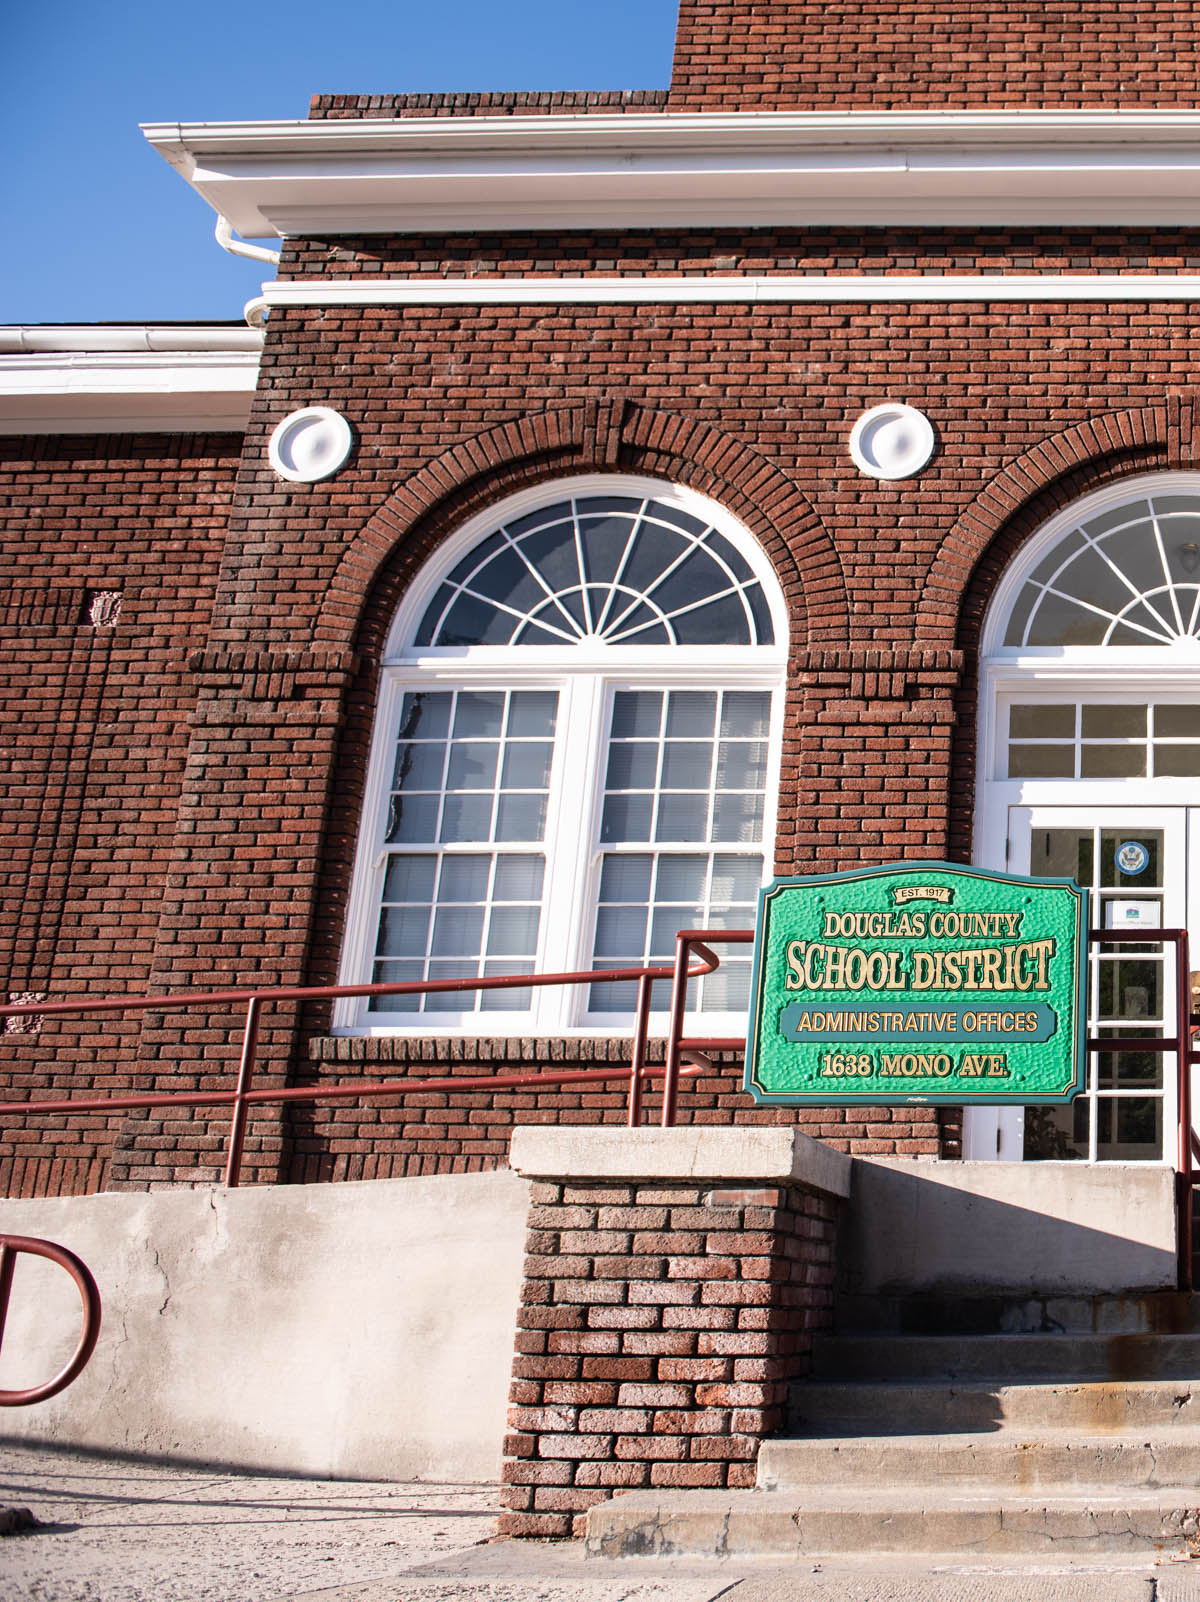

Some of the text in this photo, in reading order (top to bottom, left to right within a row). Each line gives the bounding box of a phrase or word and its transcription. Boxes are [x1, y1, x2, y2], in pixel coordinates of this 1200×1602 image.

[901, 888, 945, 898] EST. 1917
[823, 912, 1021, 938] DOUGLAS COUNTY
[785, 939, 1054, 991] SCHOOL DISTRICT
[796, 1011, 1038, 1032] ADMINISTRATIVE OFFICES
[822, 1053, 1009, 1076] 1638 MONO AVE.
